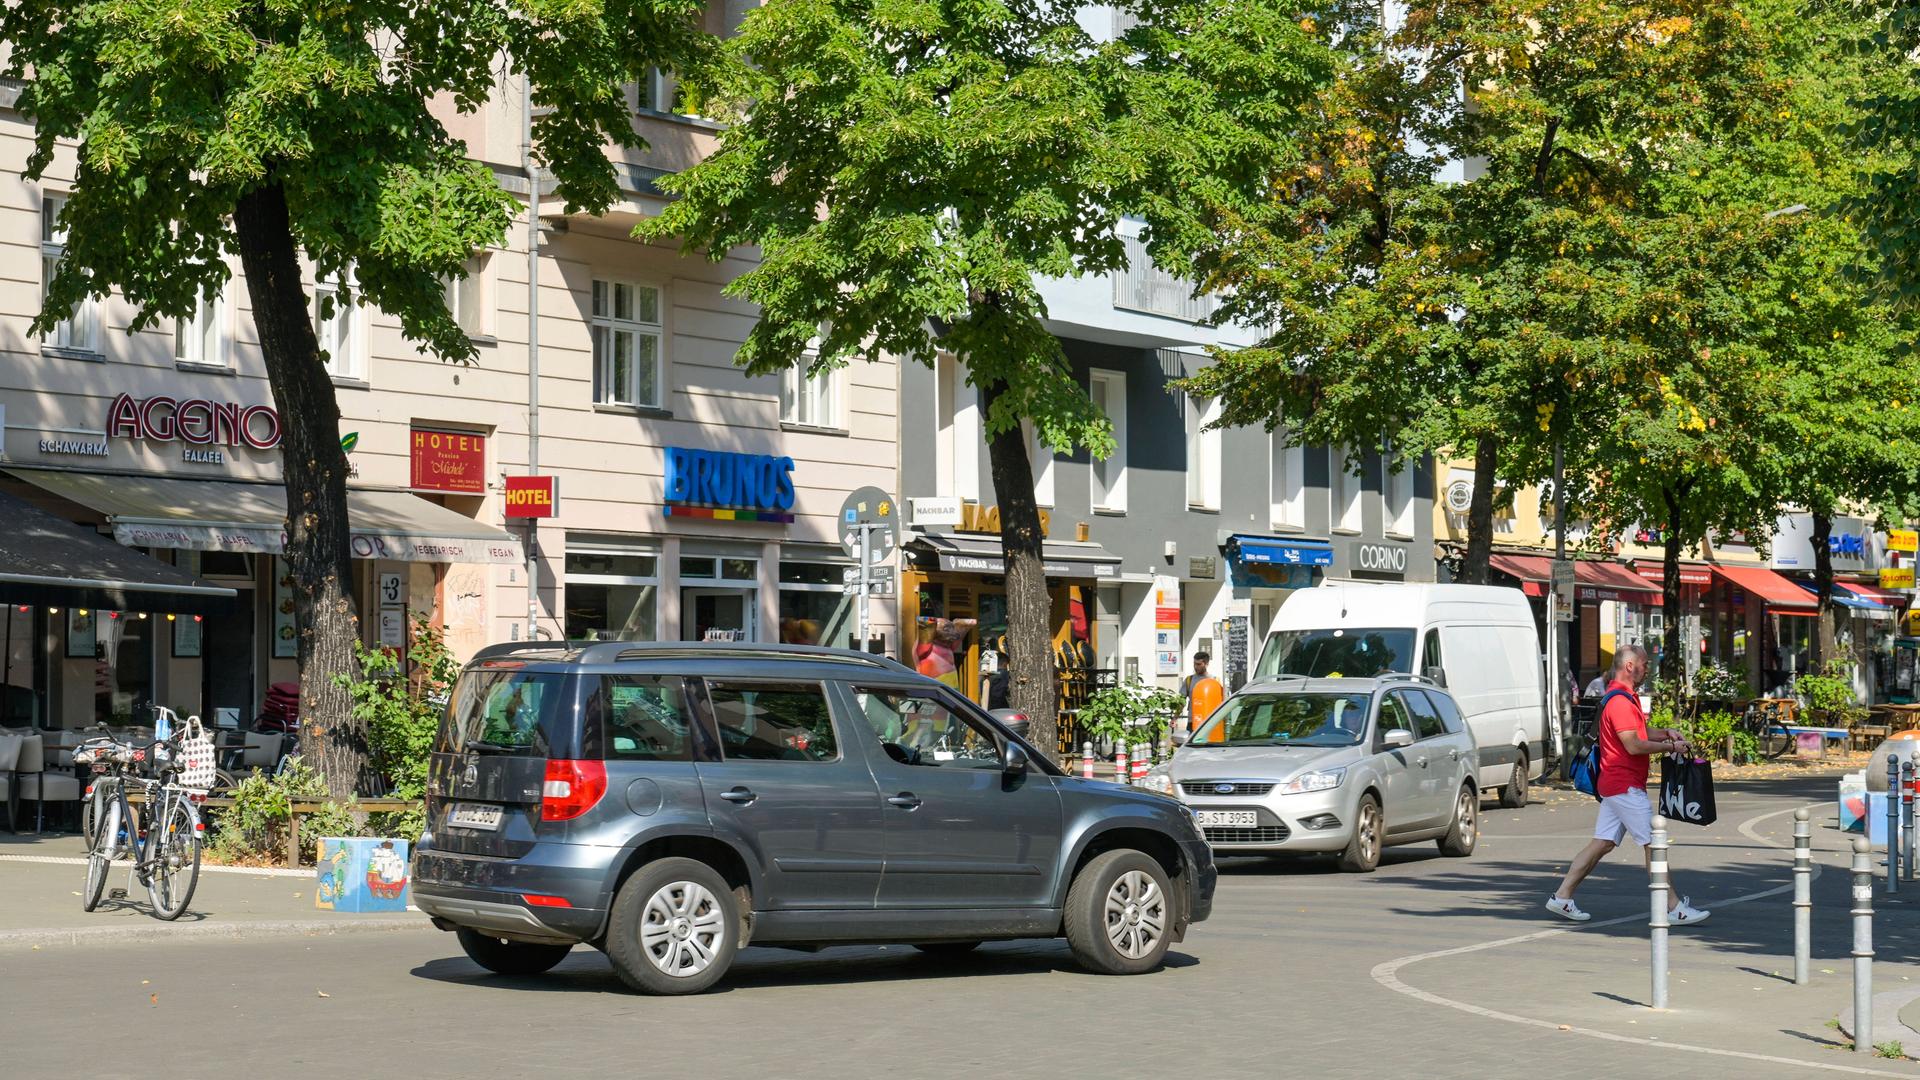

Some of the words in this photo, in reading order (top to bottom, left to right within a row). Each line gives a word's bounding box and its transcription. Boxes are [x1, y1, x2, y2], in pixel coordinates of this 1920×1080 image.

[106, 391, 282, 449] AGENO
[39, 439, 110, 457] SCHAWARMA
[415, 433, 481, 452] HOTEL
[184, 449, 225, 464] FALAFEL
[663, 446, 795, 510] BRUNOS
[507, 488, 551, 505] HOTEL
[916, 507, 956, 515] NACHBAR
[216, 535, 253, 546] FALAFEL
[413, 545, 464, 556] VEGETARISCH
[488, 548, 514, 558] VEGAN
[1360, 545, 1406, 571] CORINO
[957, 559, 988, 569] NACHBAR
[1891, 574, 1912, 582] LOTTO
[1212, 812, 1226, 824] ST
[1229, 812, 1255, 824] 3953
